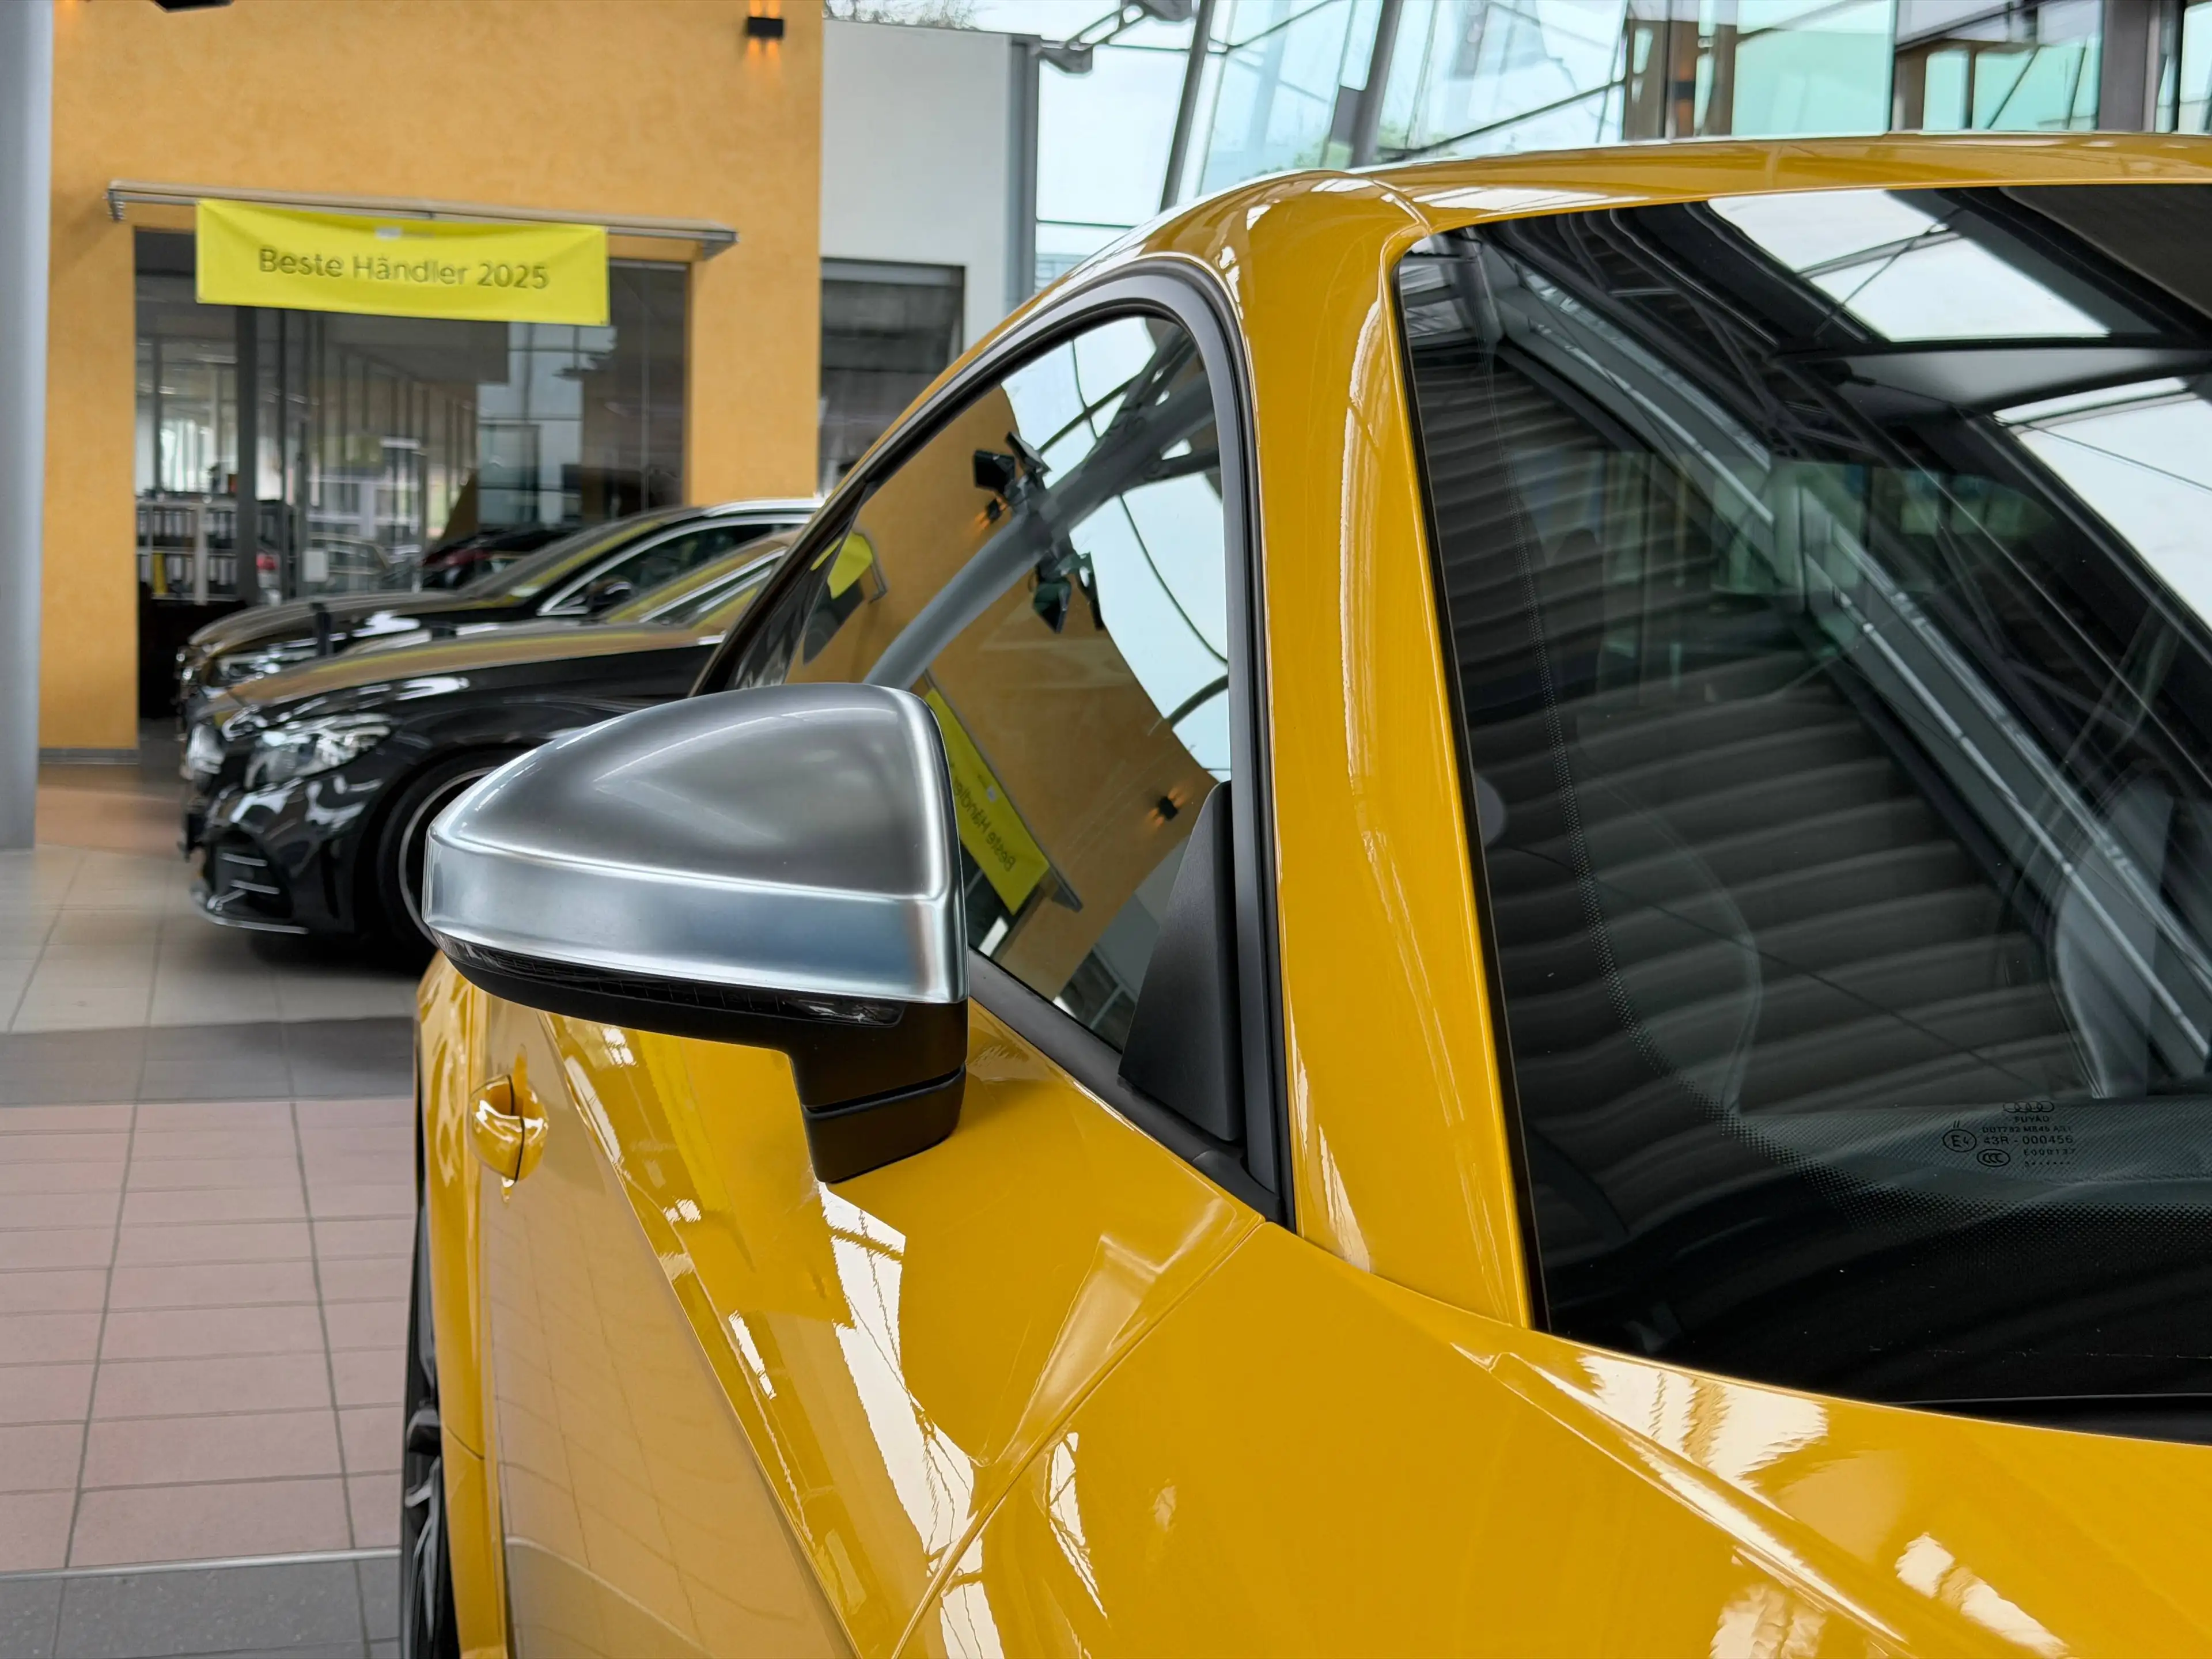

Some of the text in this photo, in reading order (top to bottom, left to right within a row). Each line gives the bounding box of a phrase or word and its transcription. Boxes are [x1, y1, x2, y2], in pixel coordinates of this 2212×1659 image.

[259, 248, 550, 290] Beste Händler 2025
[2022, 1135, 2073, 1145] 000456
